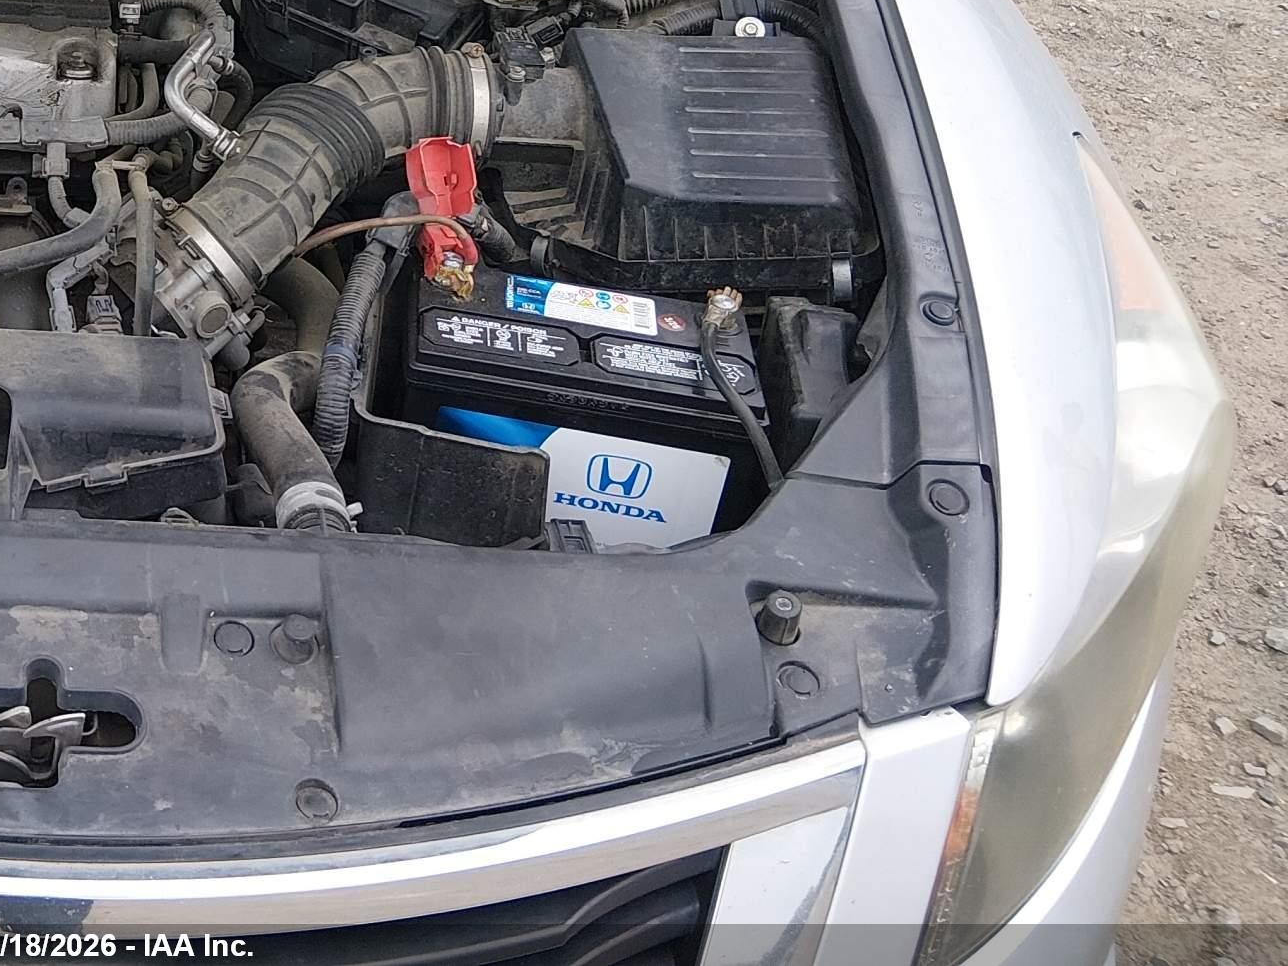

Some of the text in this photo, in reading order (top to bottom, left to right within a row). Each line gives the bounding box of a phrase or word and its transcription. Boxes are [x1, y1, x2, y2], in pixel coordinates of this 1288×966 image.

[462, 317, 501, 329] DANGER
[511, 324, 547, 336] POISON
[553, 491, 667, 523] HONDA
